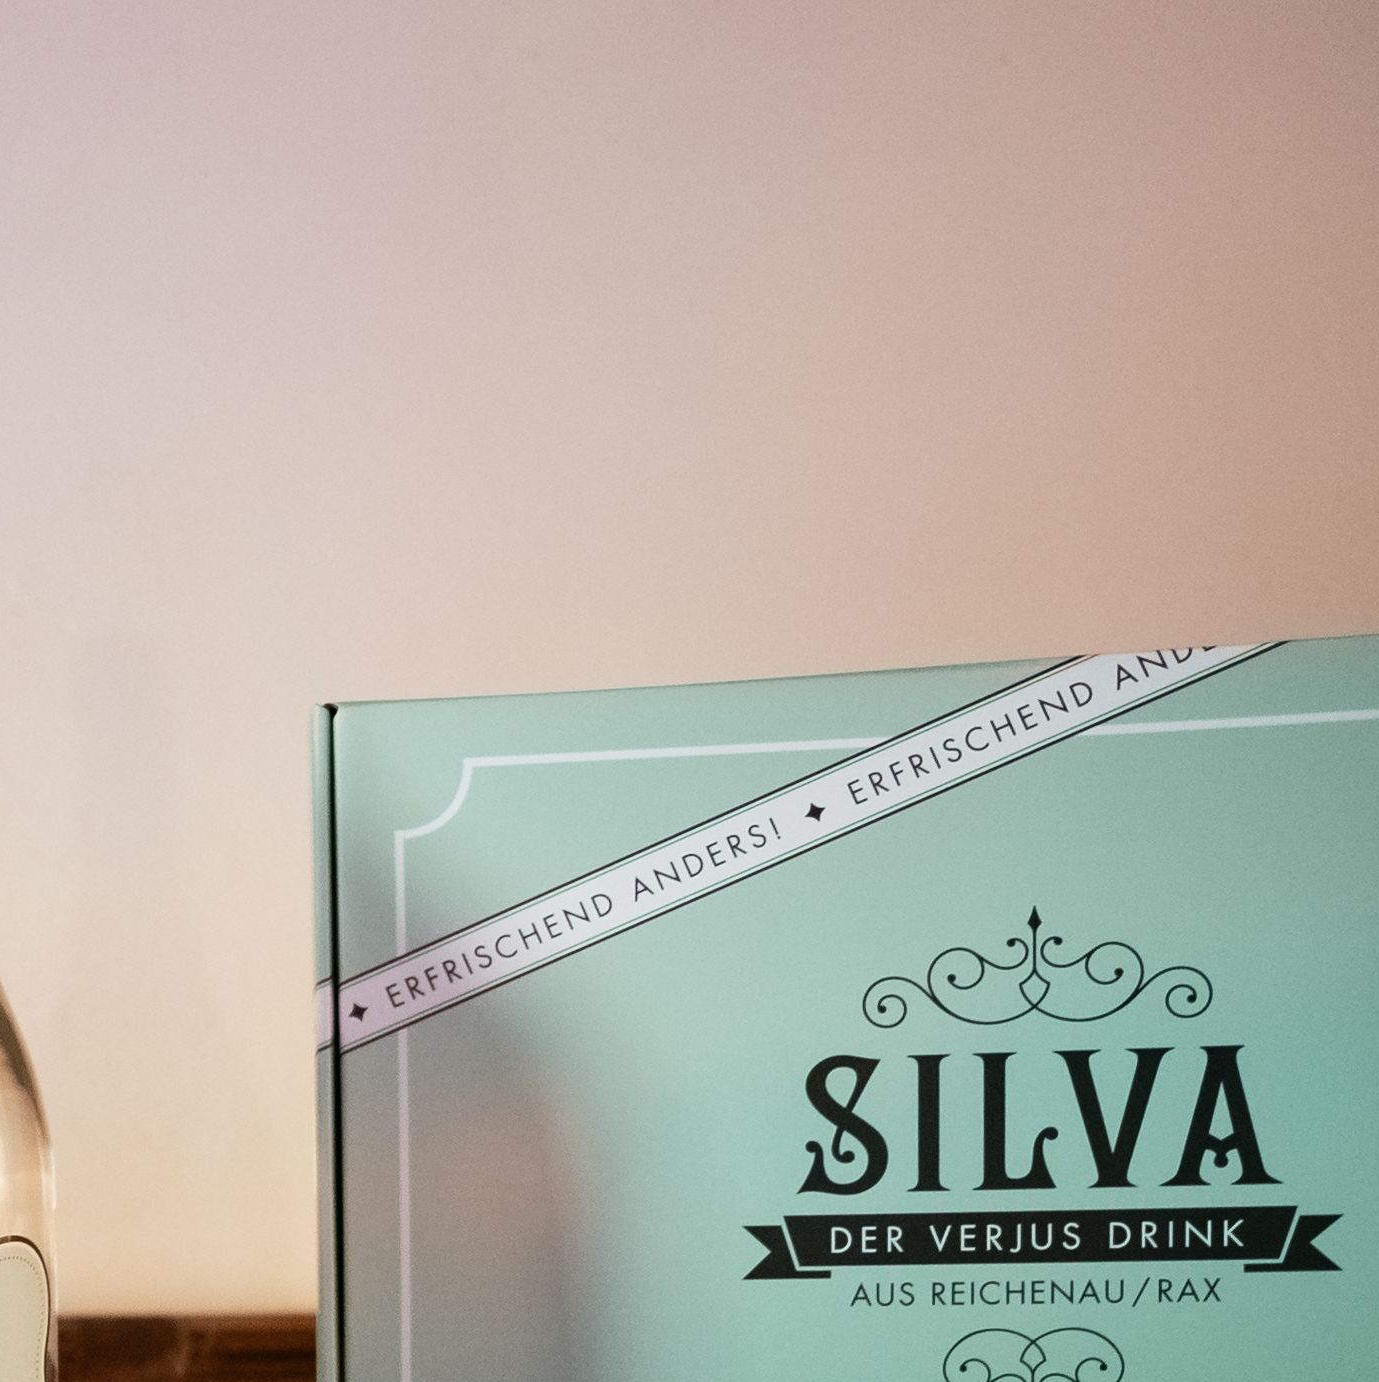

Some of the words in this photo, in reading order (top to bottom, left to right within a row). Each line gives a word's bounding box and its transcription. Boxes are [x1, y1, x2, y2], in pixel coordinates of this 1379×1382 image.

[384, 889, 615, 1010] ERFRISCHEND
[632, 816, 783, 903] ANDERS!
[846, 677, 1095, 807] ERFRISCHEND
[796, 1044, 1285, 1196] SILVA
[830, 1223, 905, 1254] DER
[928, 1221, 1082, 1254] VERJUS
[1108, 1217, 1246, 1251] DRINK
[849, 1281, 916, 1308] AUS
